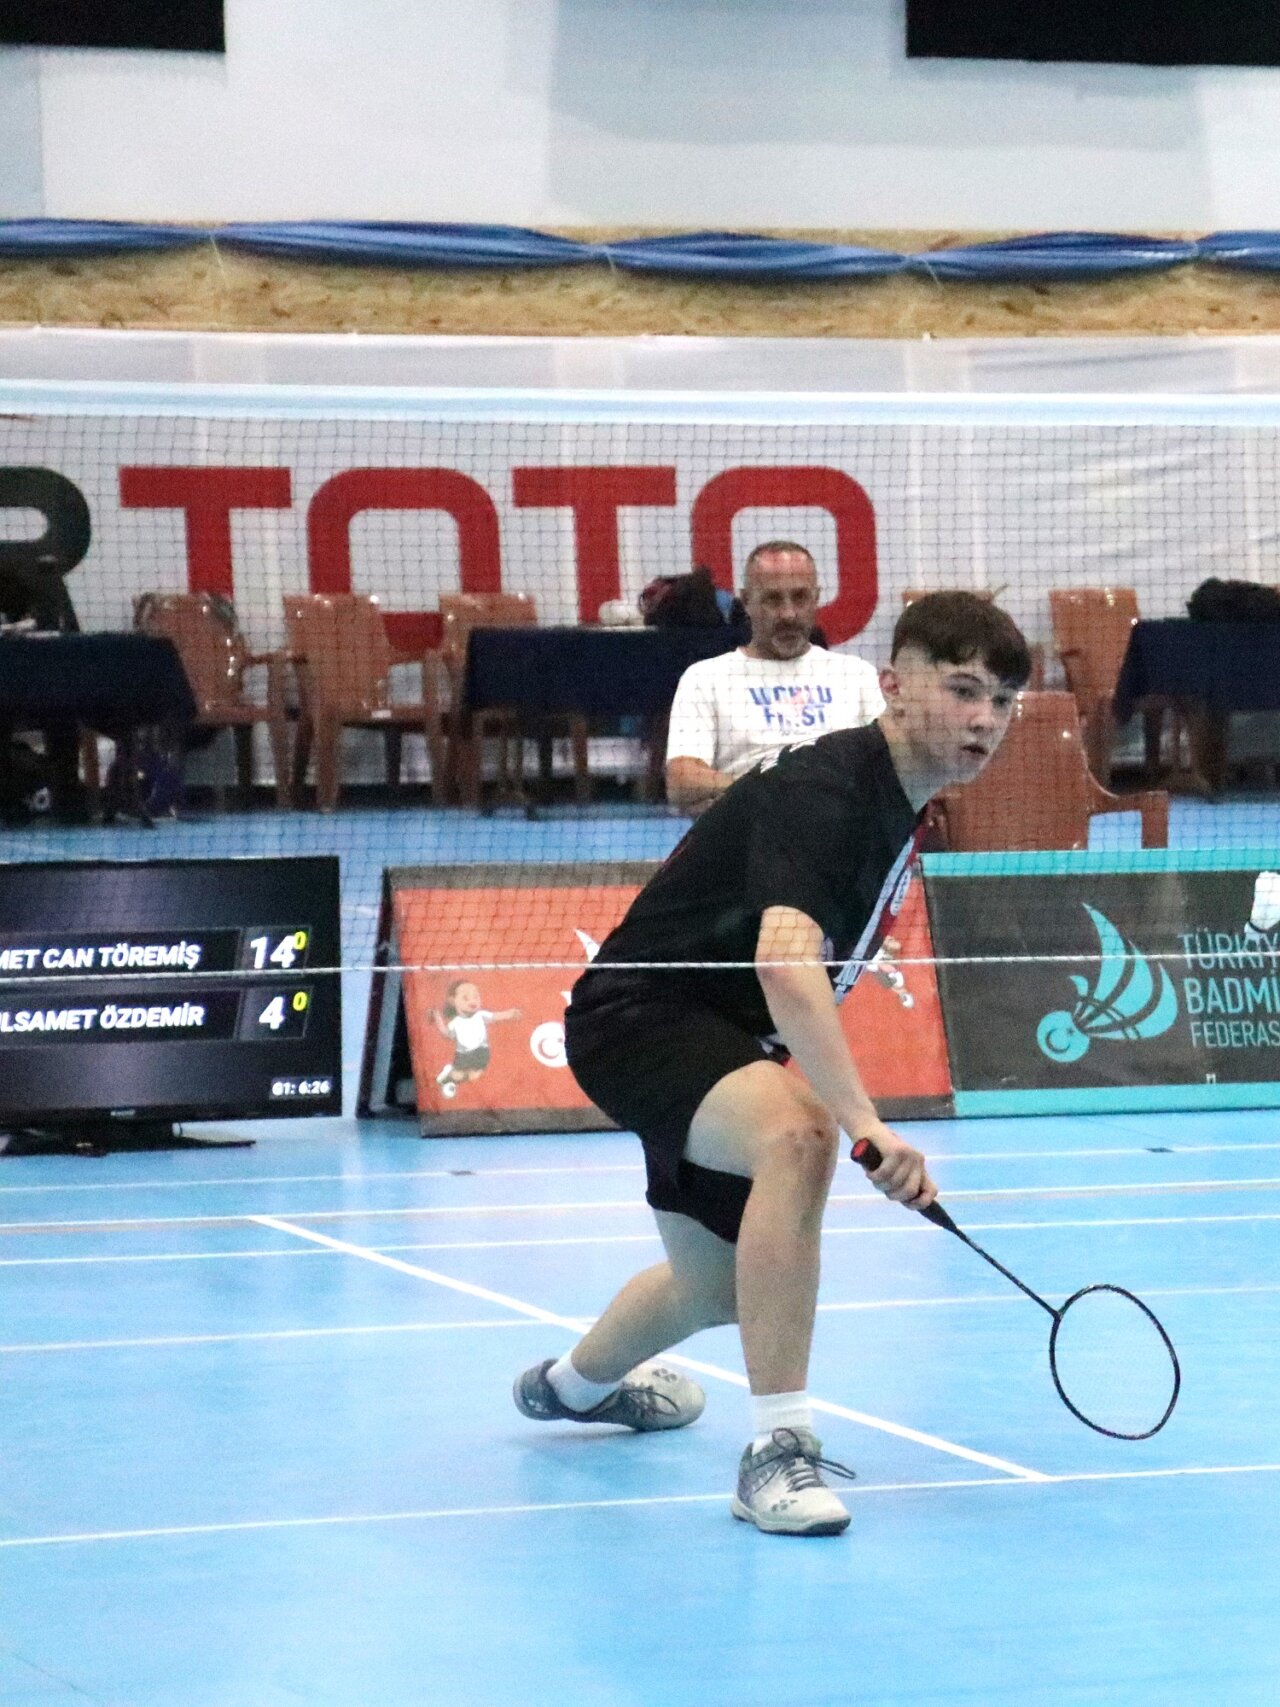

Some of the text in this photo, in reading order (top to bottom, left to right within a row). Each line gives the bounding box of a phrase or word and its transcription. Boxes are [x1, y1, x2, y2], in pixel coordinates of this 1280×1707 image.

[42, 948, 95, 968] CAN
[99, 940, 201, 970] TÖREMİŞ
[250, 935, 296, 969] 14
[0, 1008, 98, 1033] LSAMET
[100, 1002, 205, 1029] ÖZDEMİR
[258, 996, 285, 1030] 4
